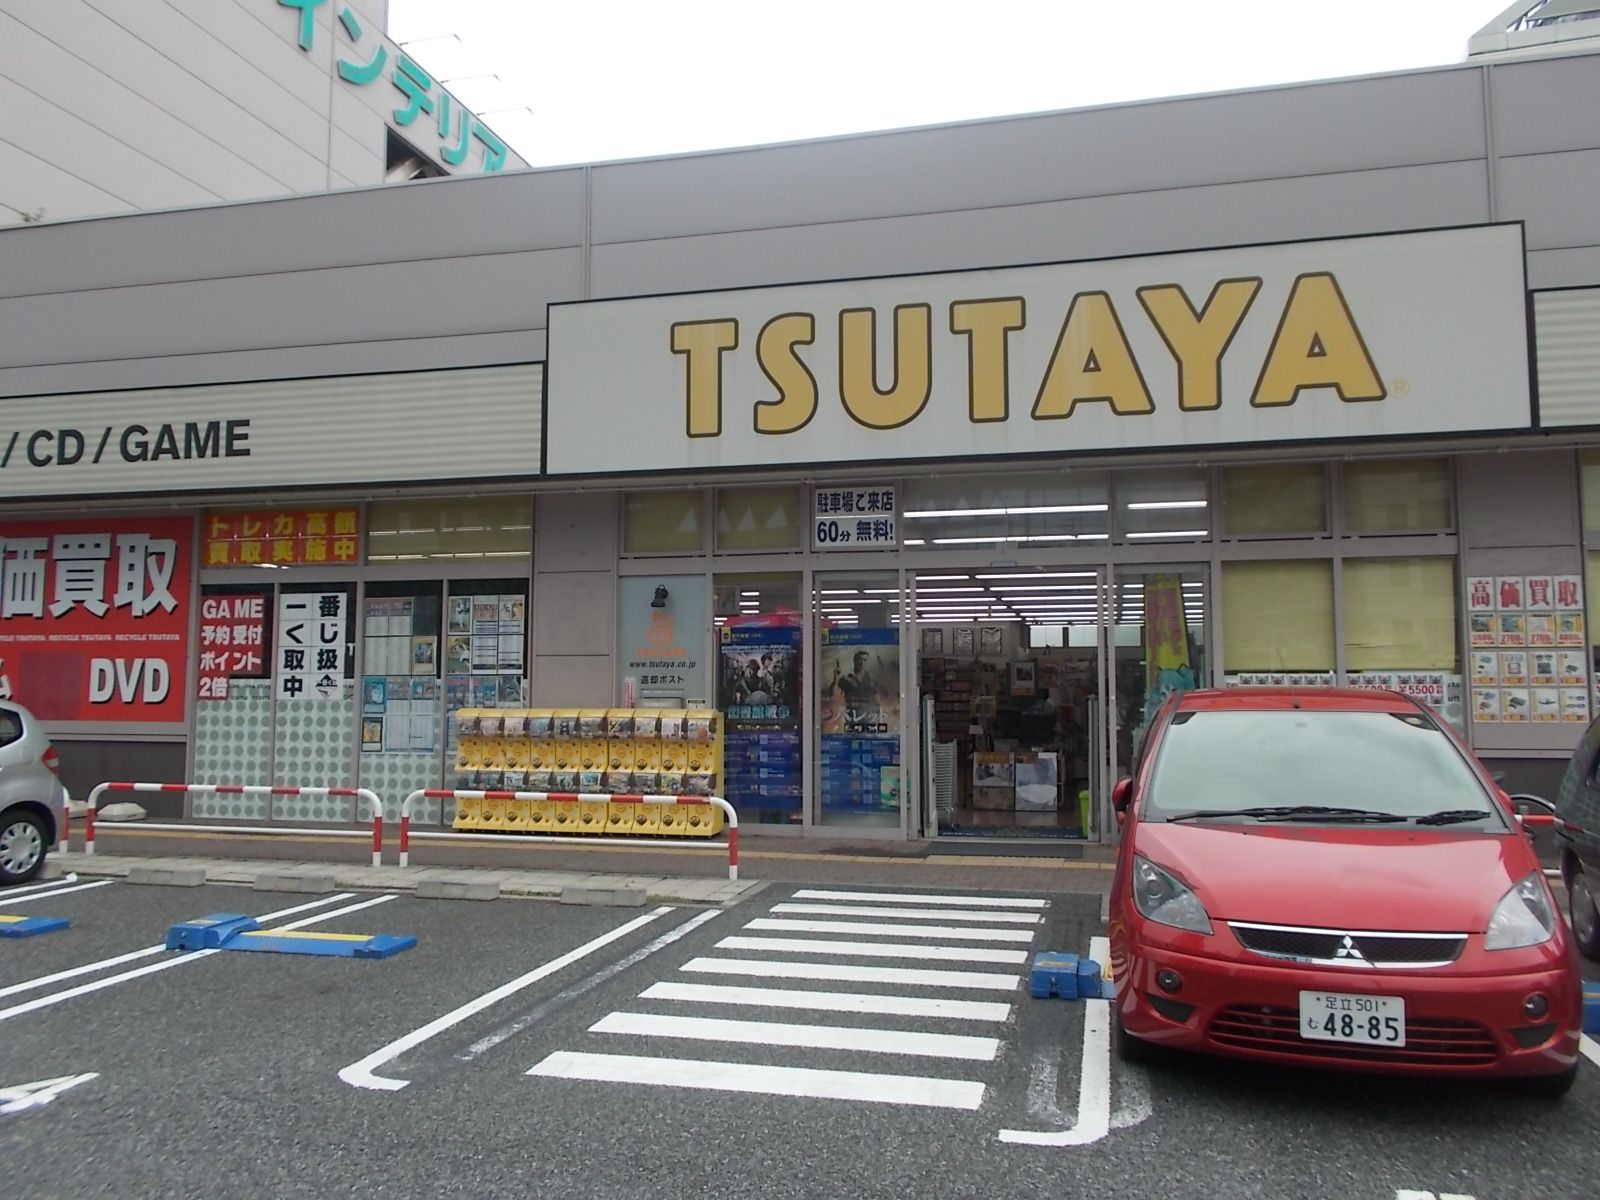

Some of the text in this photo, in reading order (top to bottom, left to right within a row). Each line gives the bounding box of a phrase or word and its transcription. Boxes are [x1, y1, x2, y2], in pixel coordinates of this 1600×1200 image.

[669, 270, 1388, 438] TSUTAYA
[817, 490, 894, 513] 駐車場ご来店
[817, 520, 851, 543] 60分
[208, 538, 356, 564] 買取実施中
[202, 598, 264, 619] GAME
[200, 651, 262, 672] ポイント
[89, 657, 170, 703] DVD
[199, 676, 229, 698] 2倍
[1325, 996, 1379, 1012] 足立 501
[1323, 1012, 1399, 1042] 48-85
